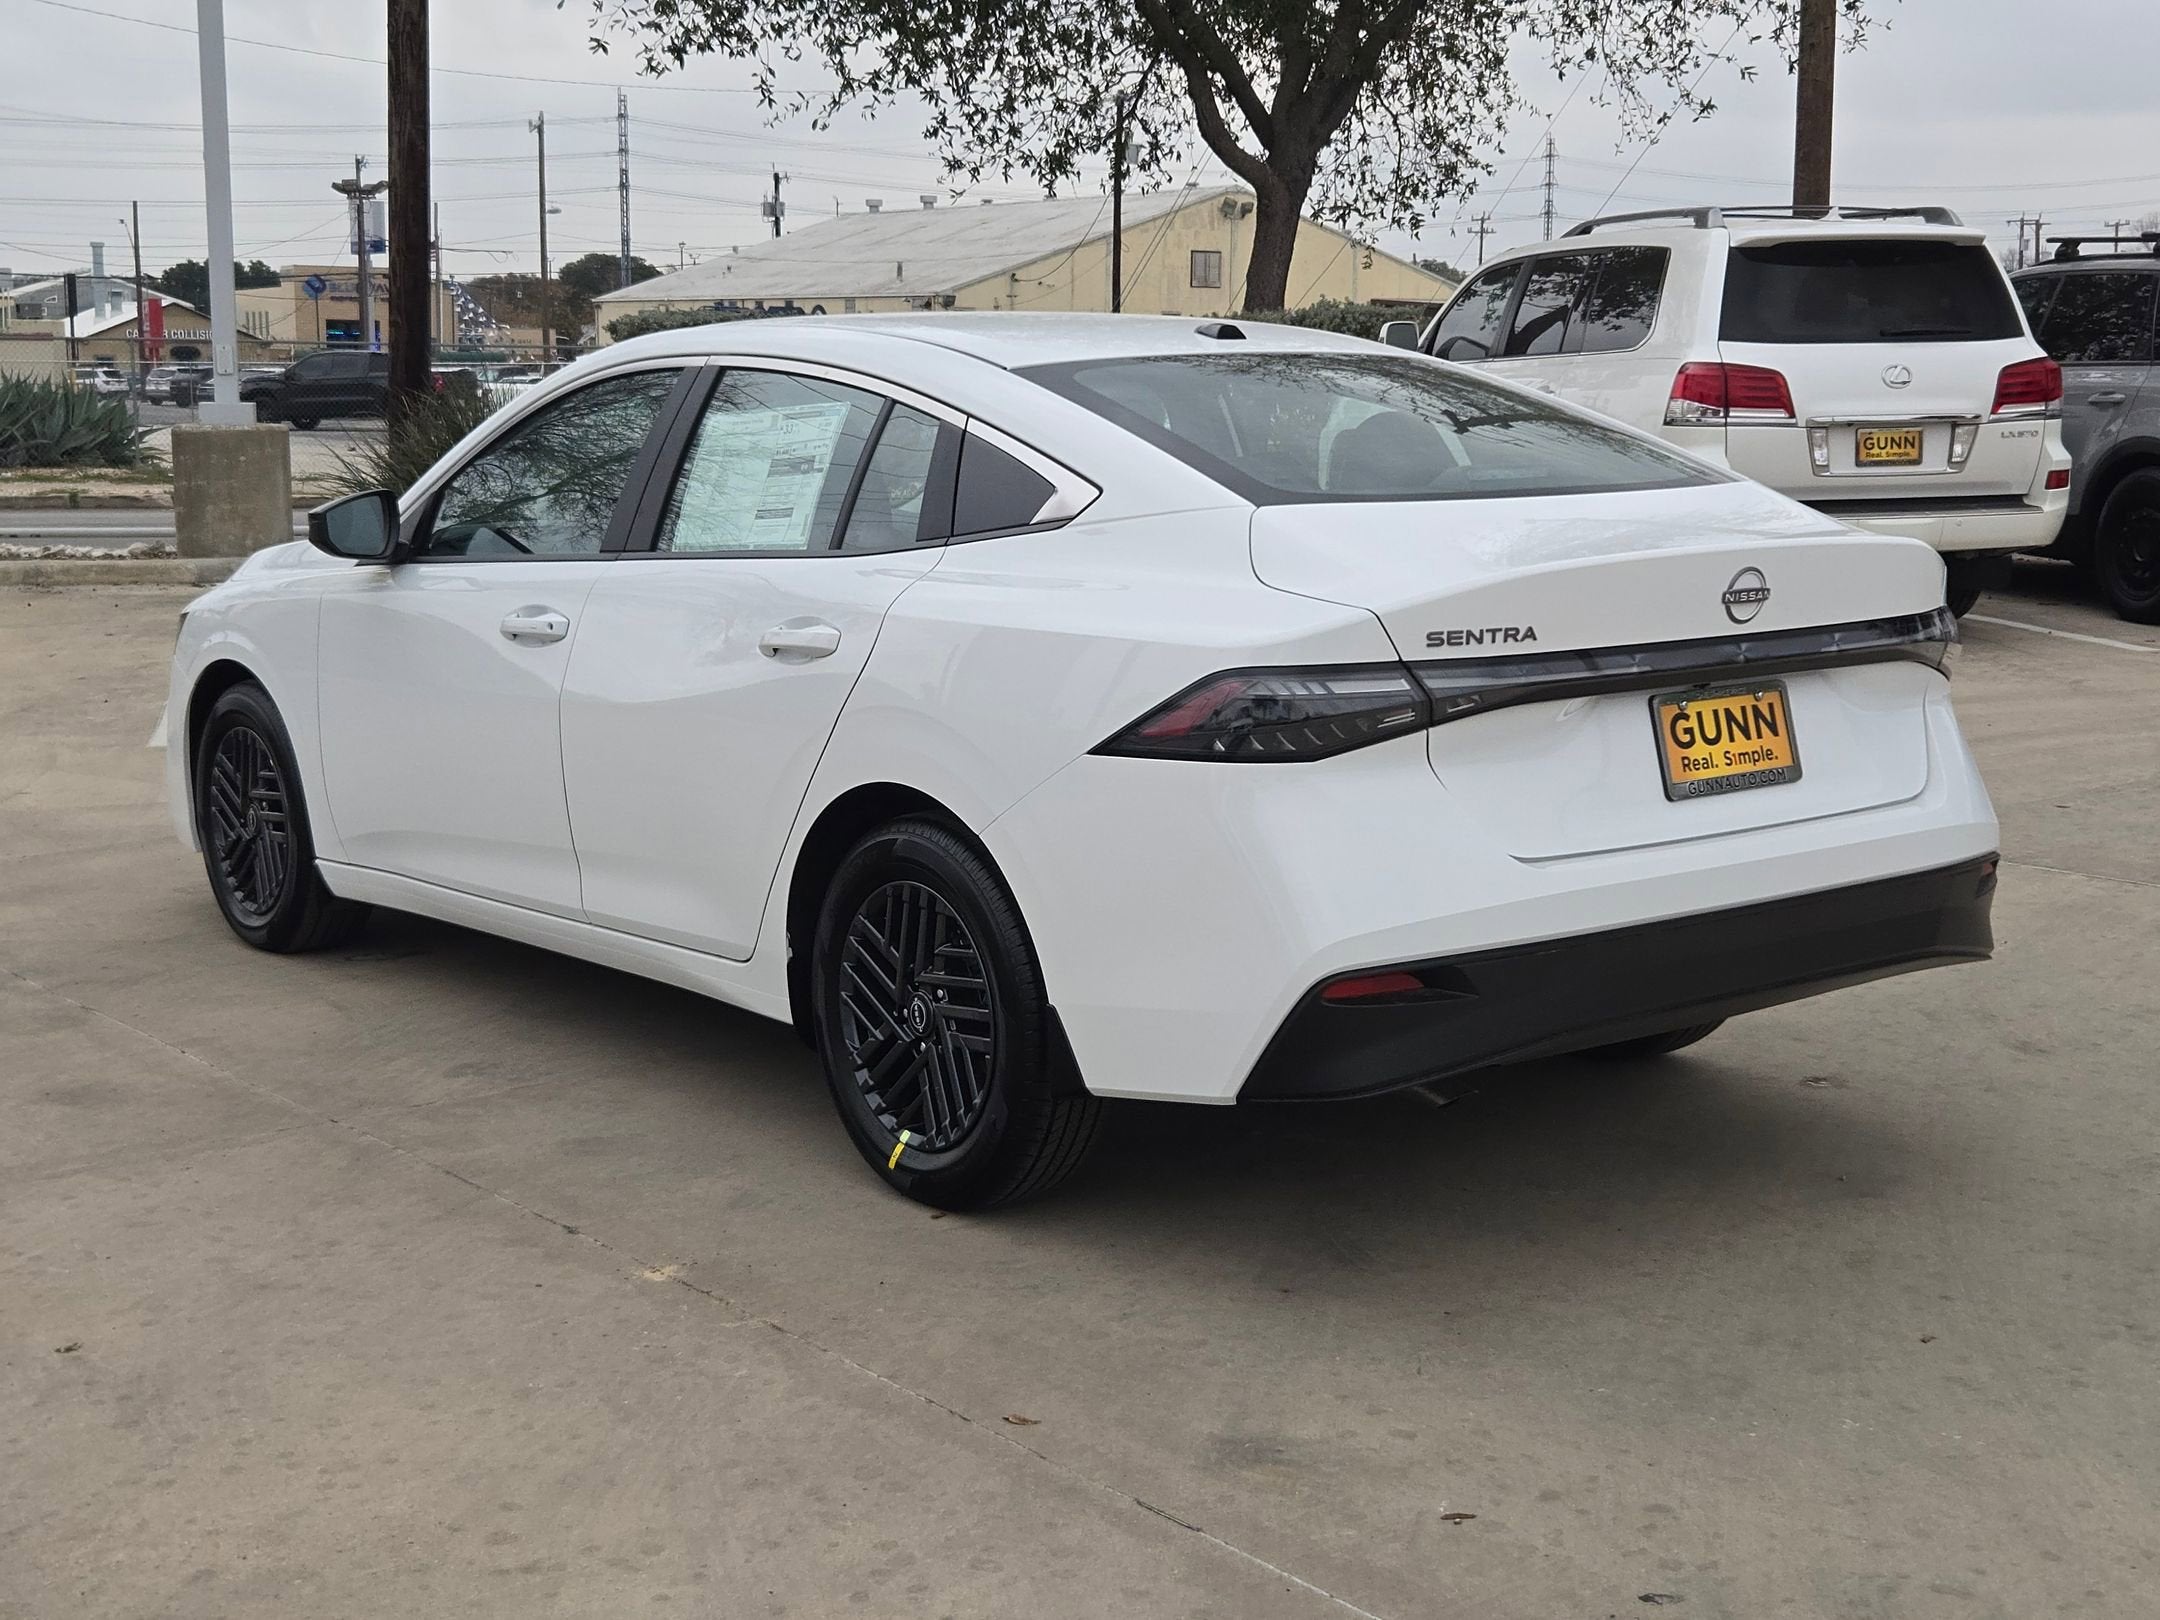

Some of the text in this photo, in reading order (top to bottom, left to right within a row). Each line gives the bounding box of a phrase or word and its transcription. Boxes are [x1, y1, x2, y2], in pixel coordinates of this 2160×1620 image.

[171, 329, 213, 340] COLLISI
[1863, 436, 1916, 451] GUNN
[1724, 590, 1770, 602] NISSAN
[1425, 626, 1538, 648] SENTRA
[1670, 702, 1780, 749] GUNN
[1681, 752, 1719, 772] Real.
[1687, 769, 1787, 795] GUNNAUTO.COM
